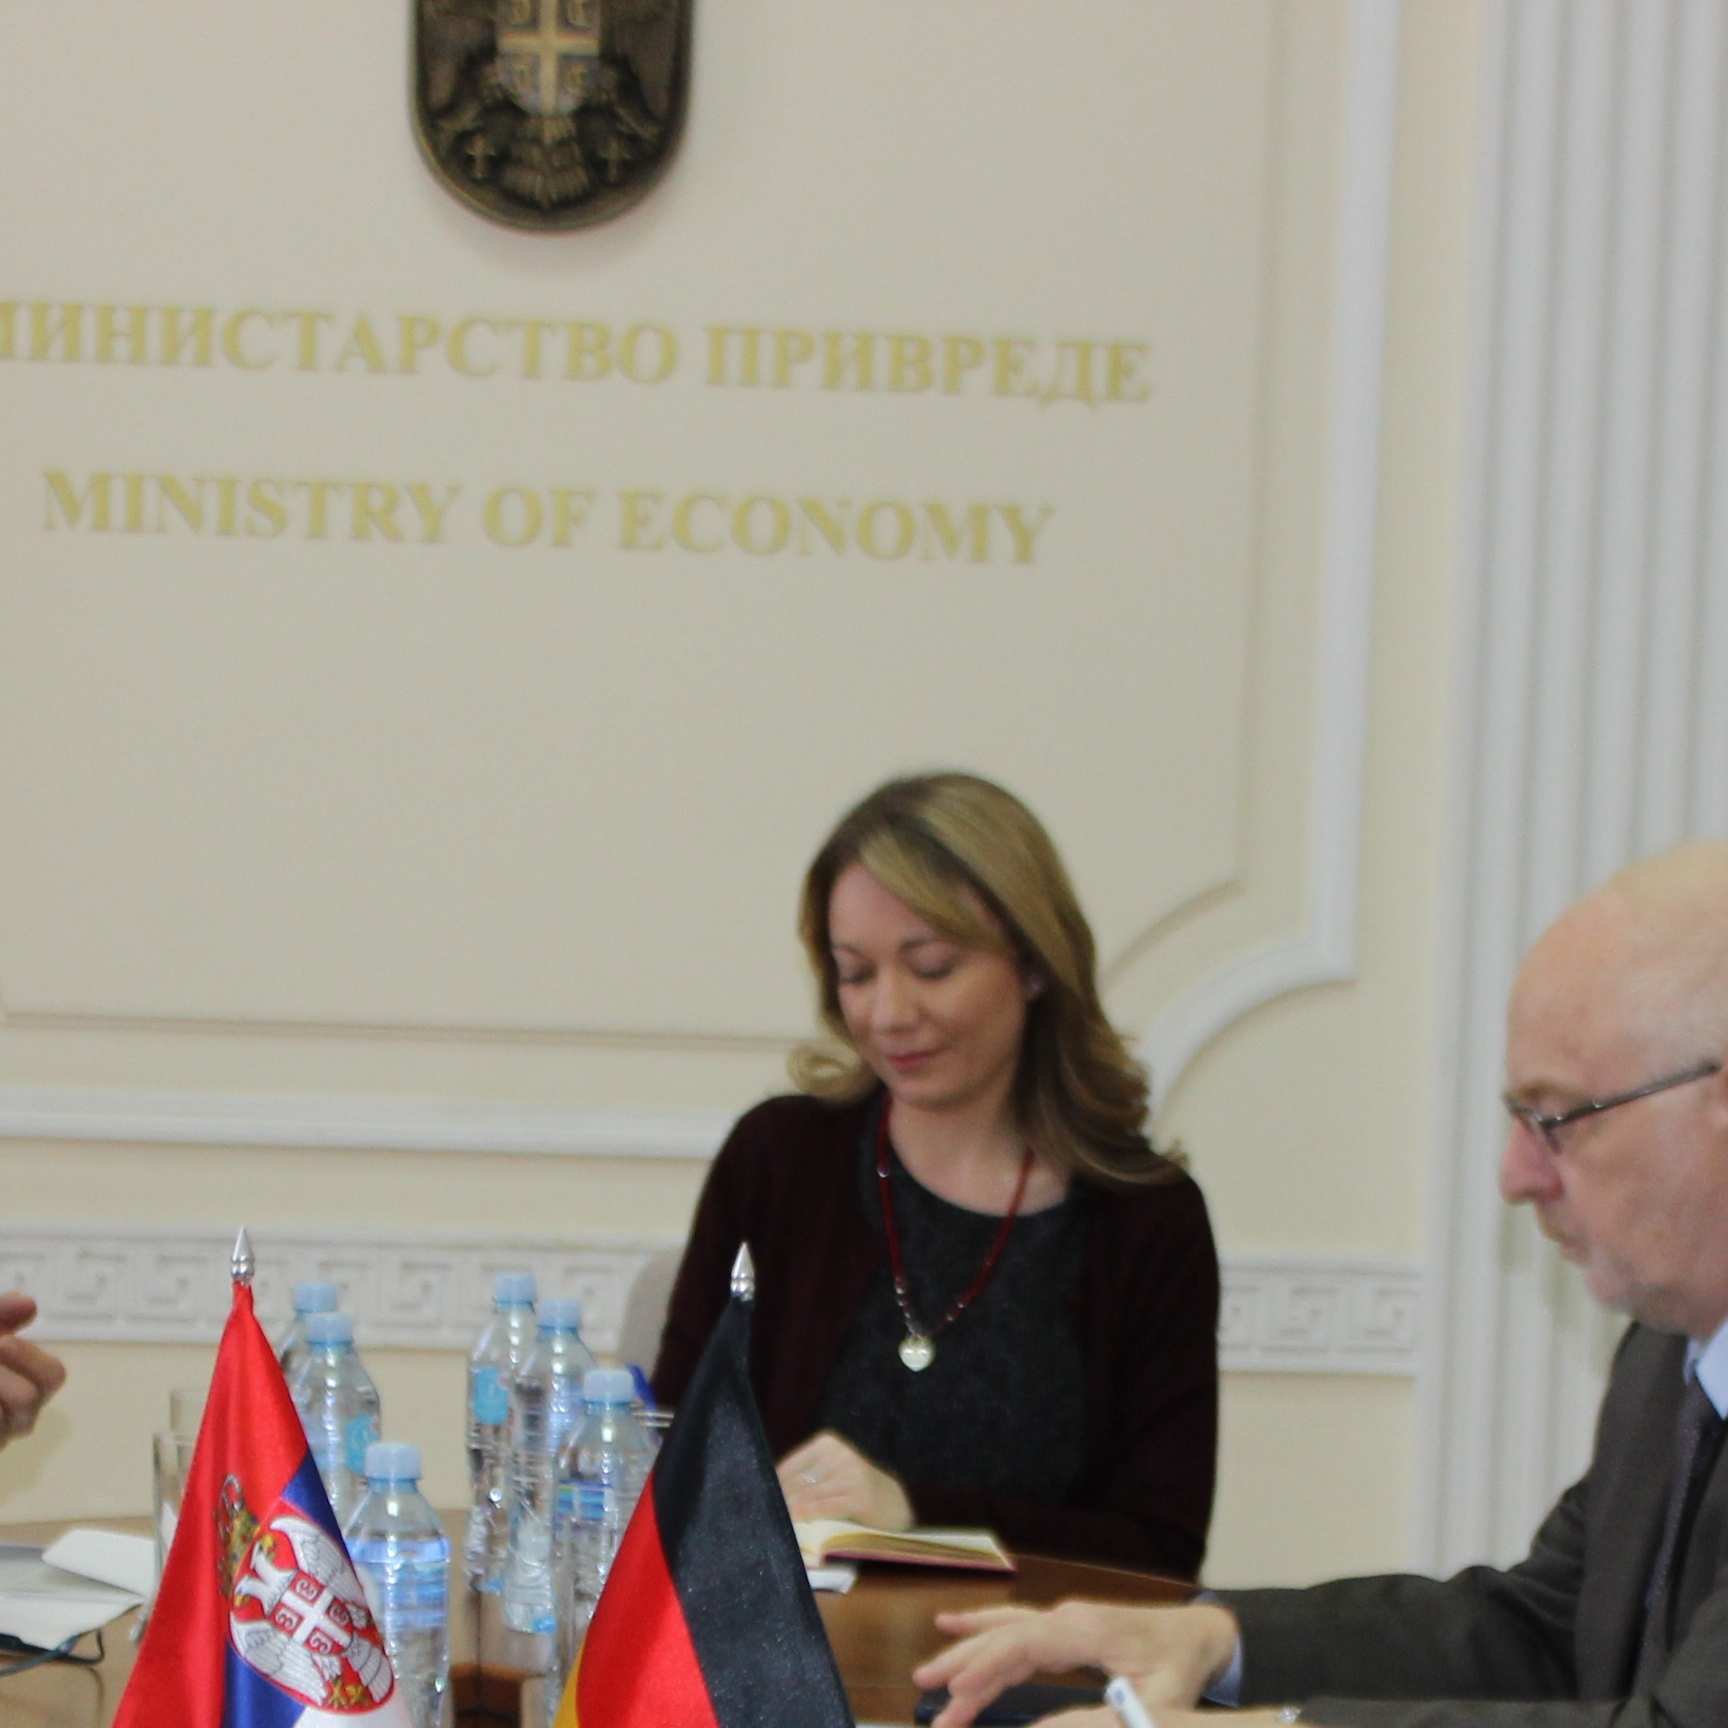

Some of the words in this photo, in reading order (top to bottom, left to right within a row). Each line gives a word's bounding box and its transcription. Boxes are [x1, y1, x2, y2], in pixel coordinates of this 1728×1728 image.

[703, 323, 1151, 412] ПРИВРЕДЕ
[42, 471, 462, 544] MINISTRY
[480, 486, 594, 548] OF
[618, 489, 1055, 566] ECONOMY
